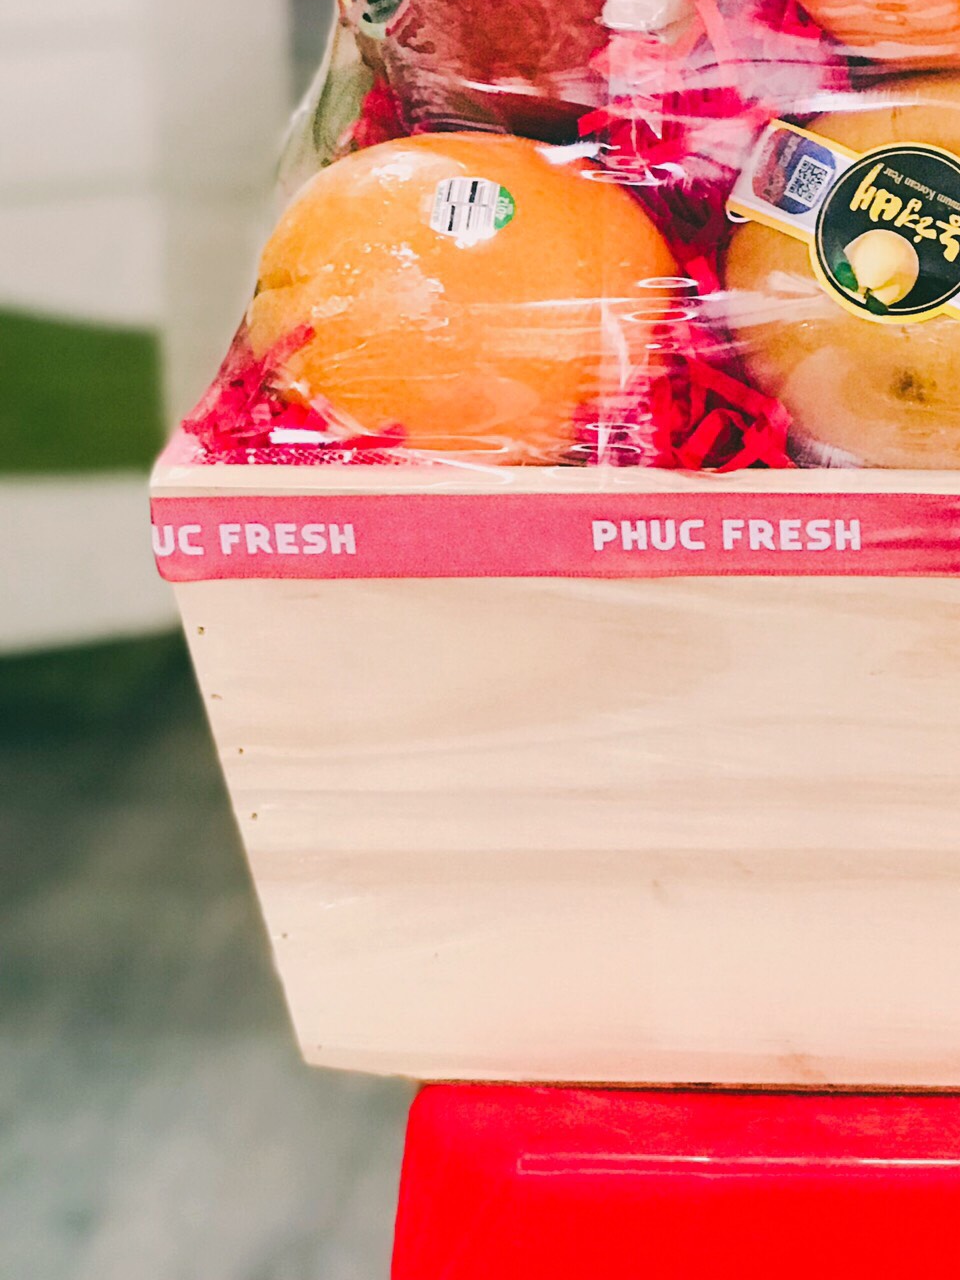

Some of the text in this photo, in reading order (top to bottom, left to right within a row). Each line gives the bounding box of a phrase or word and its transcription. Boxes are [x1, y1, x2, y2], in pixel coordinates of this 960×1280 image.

[883, 165, 903, 184] Pear
[903, 176, 935, 200] Korean
[219, 523, 356, 555] FRESH
[592, 519, 861, 551] PHUC FRESH
